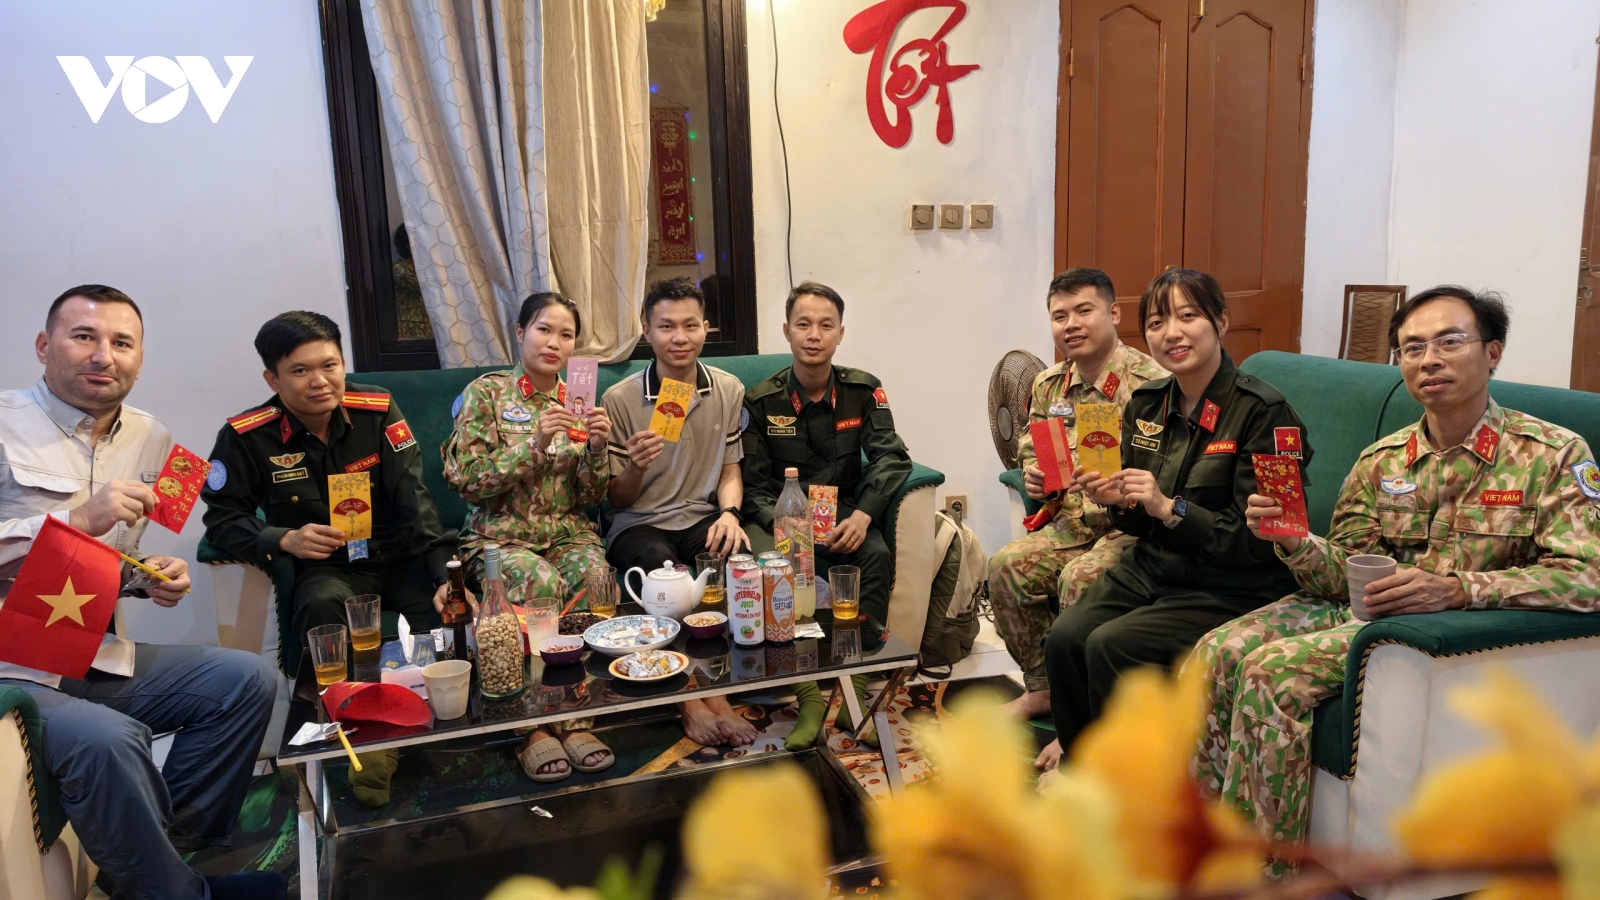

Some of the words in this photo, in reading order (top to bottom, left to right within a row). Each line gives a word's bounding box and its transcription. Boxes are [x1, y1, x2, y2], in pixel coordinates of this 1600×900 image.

[571, 371, 593, 386] Tết
[396, 439, 415, 449] POLICE
[740, 600, 754, 608] JUICE
